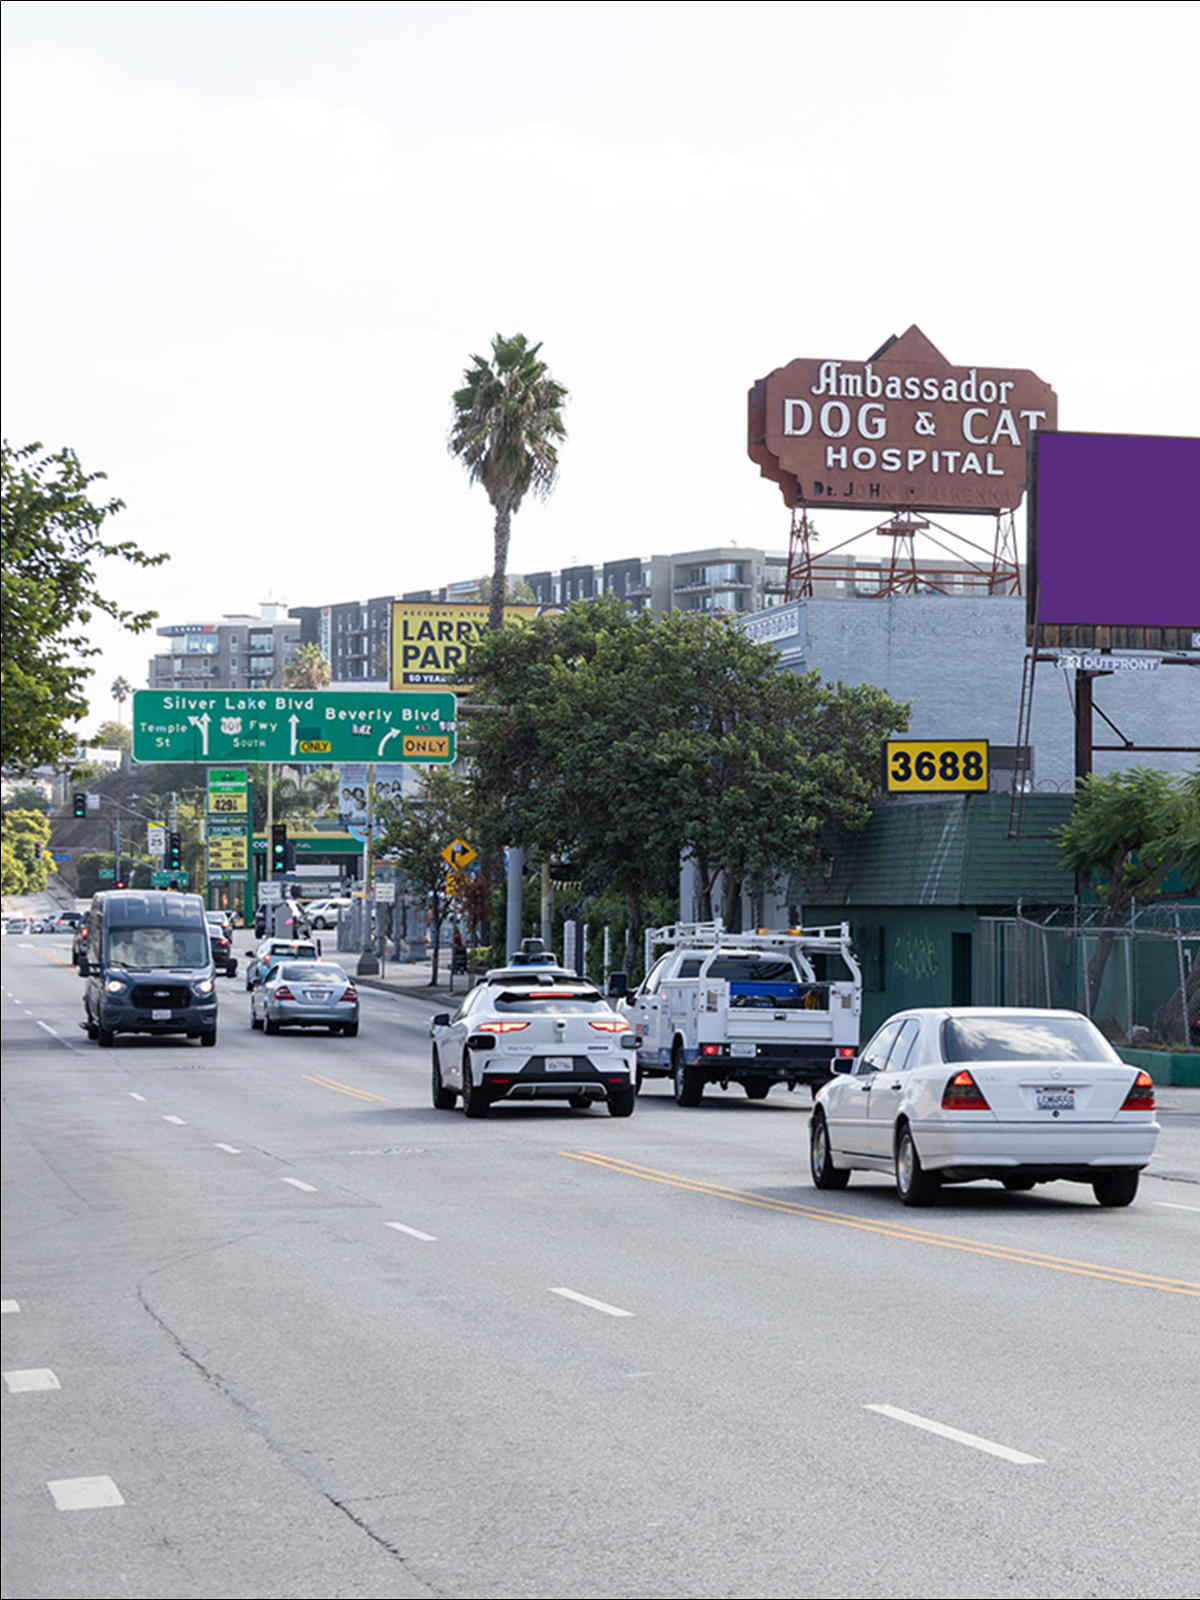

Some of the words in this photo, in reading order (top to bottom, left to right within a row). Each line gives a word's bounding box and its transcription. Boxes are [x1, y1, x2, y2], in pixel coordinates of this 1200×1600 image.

[811, 361, 1014, 404] Ambassador
[783, 398, 887, 440] DOG
[914, 411, 936, 436] &
[962, 407, 1047, 446] CAT
[826, 446, 1004, 476] HOSPITAL
[1084, 656, 1159, 670] OUTFRONT
[163, 696, 216, 709] Silver
[225, 697, 267, 709] Lake
[276, 698, 313, 710] Blvd
[325, 707, 392, 723] Beverly
[402, 708, 439, 721] Blvd
[140, 722, 187, 734] Temple
[250, 721, 277, 732] Fwy
[156, 737, 170, 748] St
[301, 742, 329, 752] ONLY
[405, 740, 446, 752] ONLY
[891, 751, 983, 782] 3688
